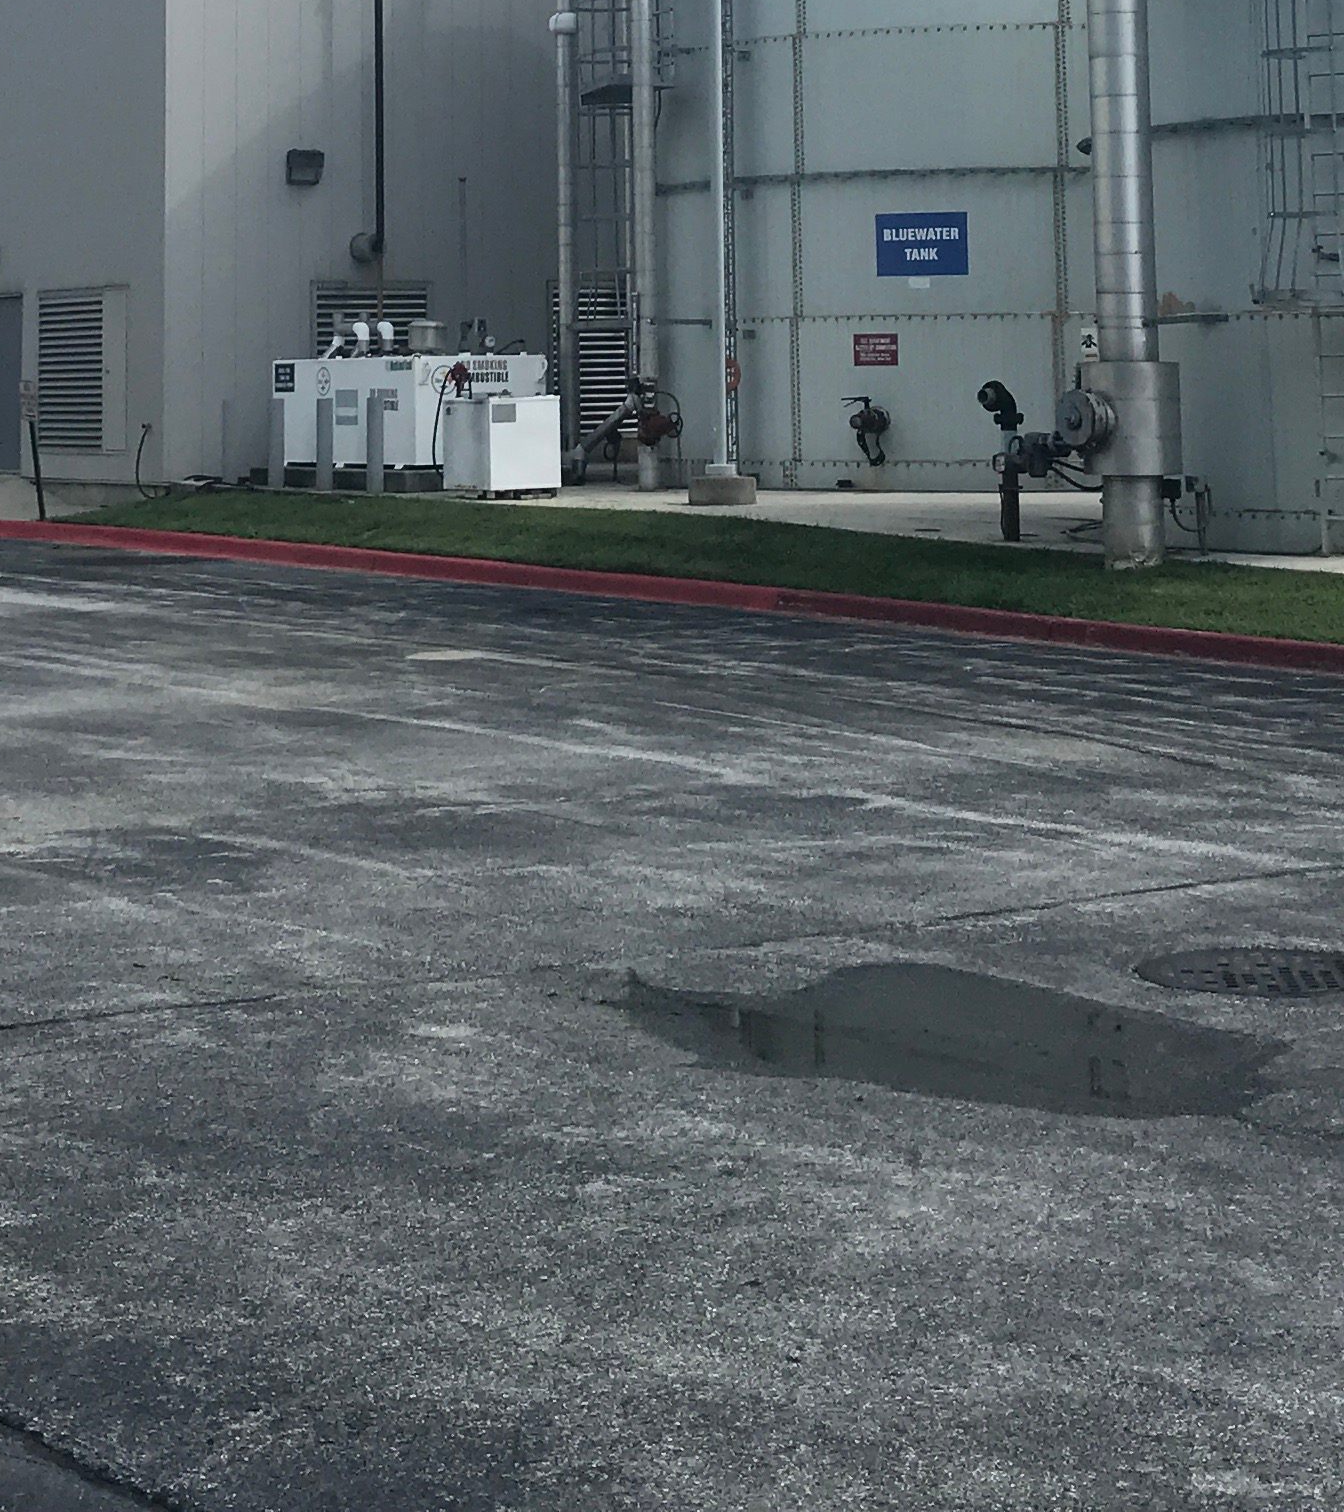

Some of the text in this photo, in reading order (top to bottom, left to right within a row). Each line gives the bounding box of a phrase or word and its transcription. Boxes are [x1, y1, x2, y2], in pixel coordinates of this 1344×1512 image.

[883, 227, 959, 241] BLUEWATER
[904, 247, 938, 261] TANK
[469, 371, 509, 383] MBUSTIBLE
